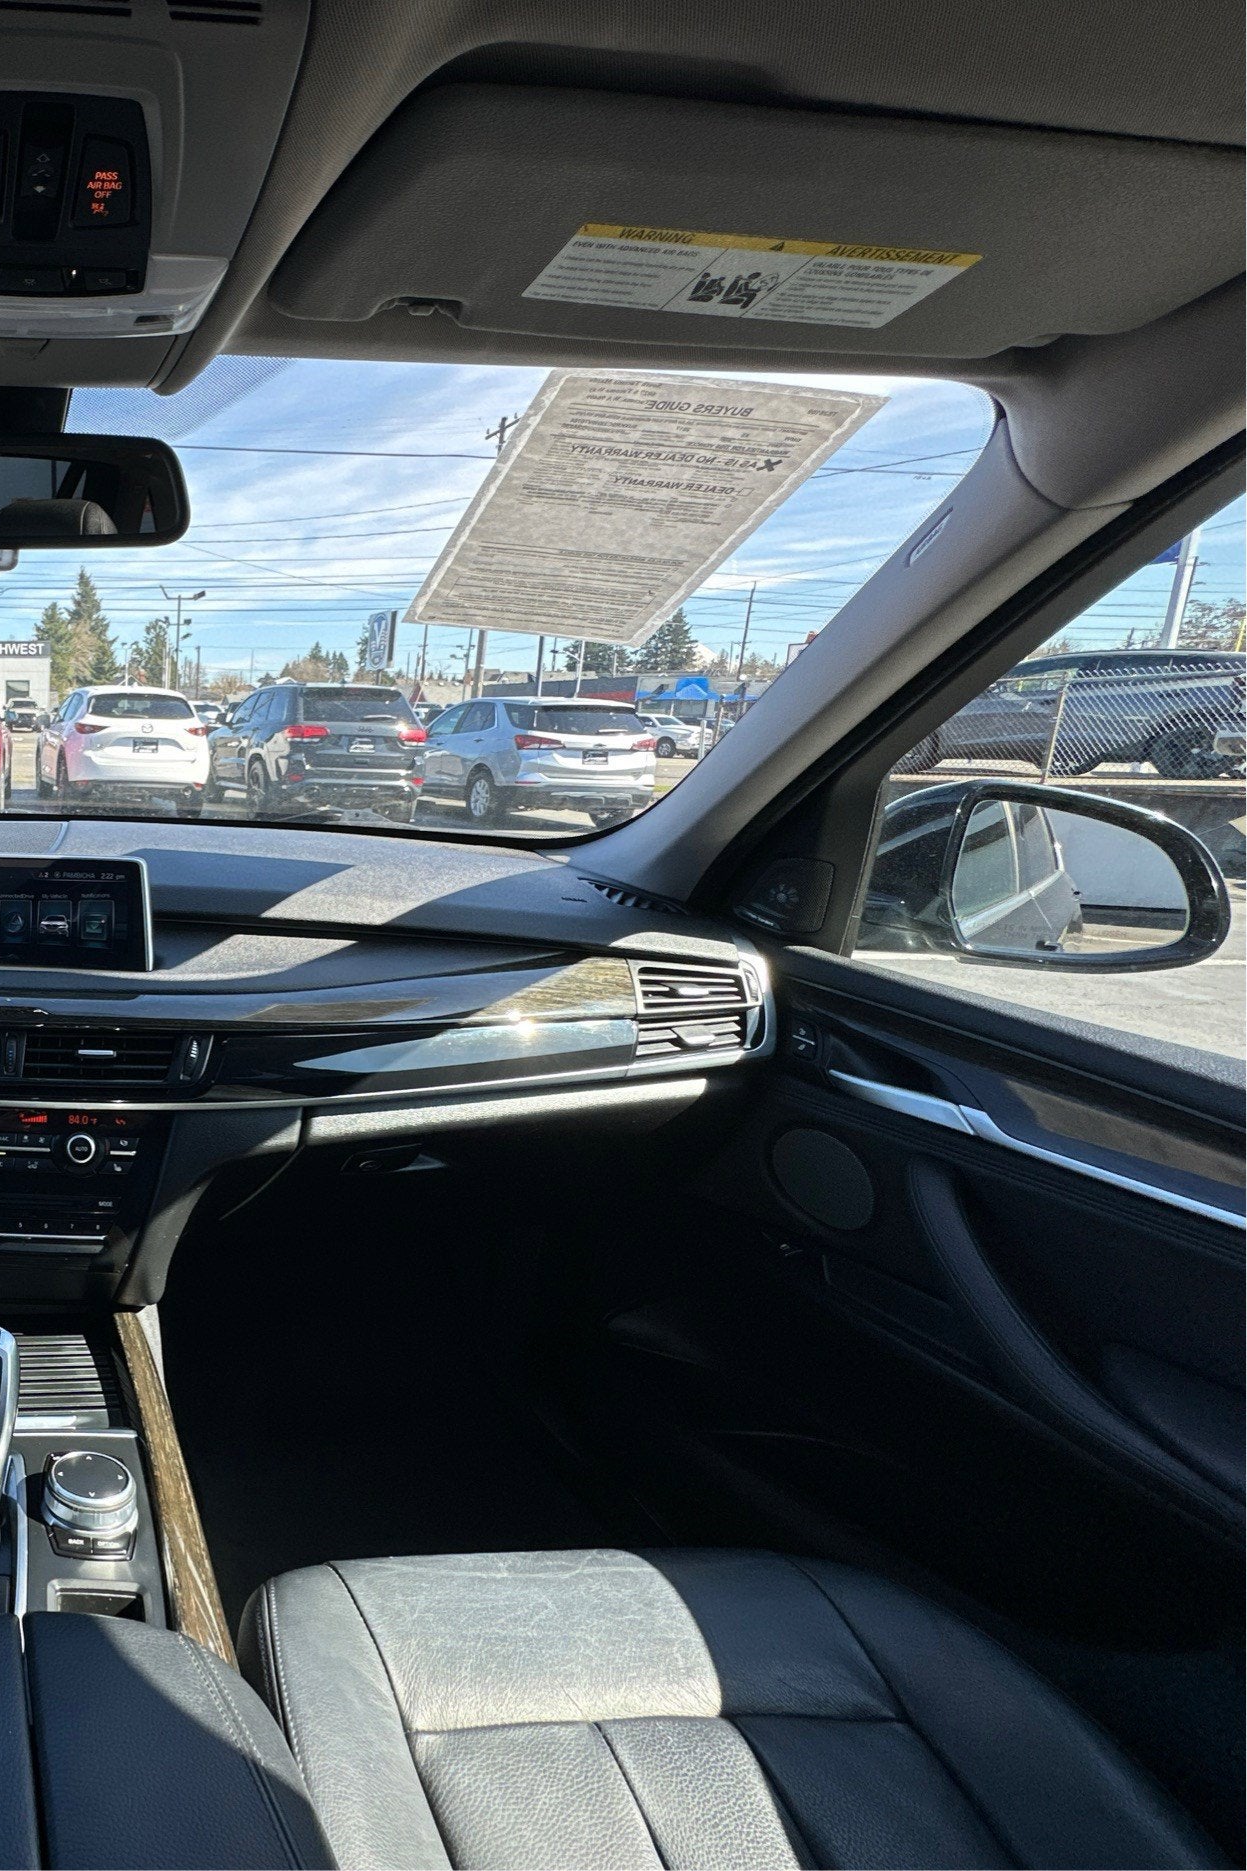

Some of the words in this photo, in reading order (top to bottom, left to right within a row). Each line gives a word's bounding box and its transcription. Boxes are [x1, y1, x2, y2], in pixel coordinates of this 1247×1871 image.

[95, 172, 118, 180] PASS
[87, 182, 102, 190] AIR
[103, 182, 122, 190] BAG
[94, 191, 112, 199] OFF
[619, 227, 697, 244] WARNING
[826, 244, 960, 264] AVERTISSEMENT
[67, 1114, 89, 1125] 84.0
